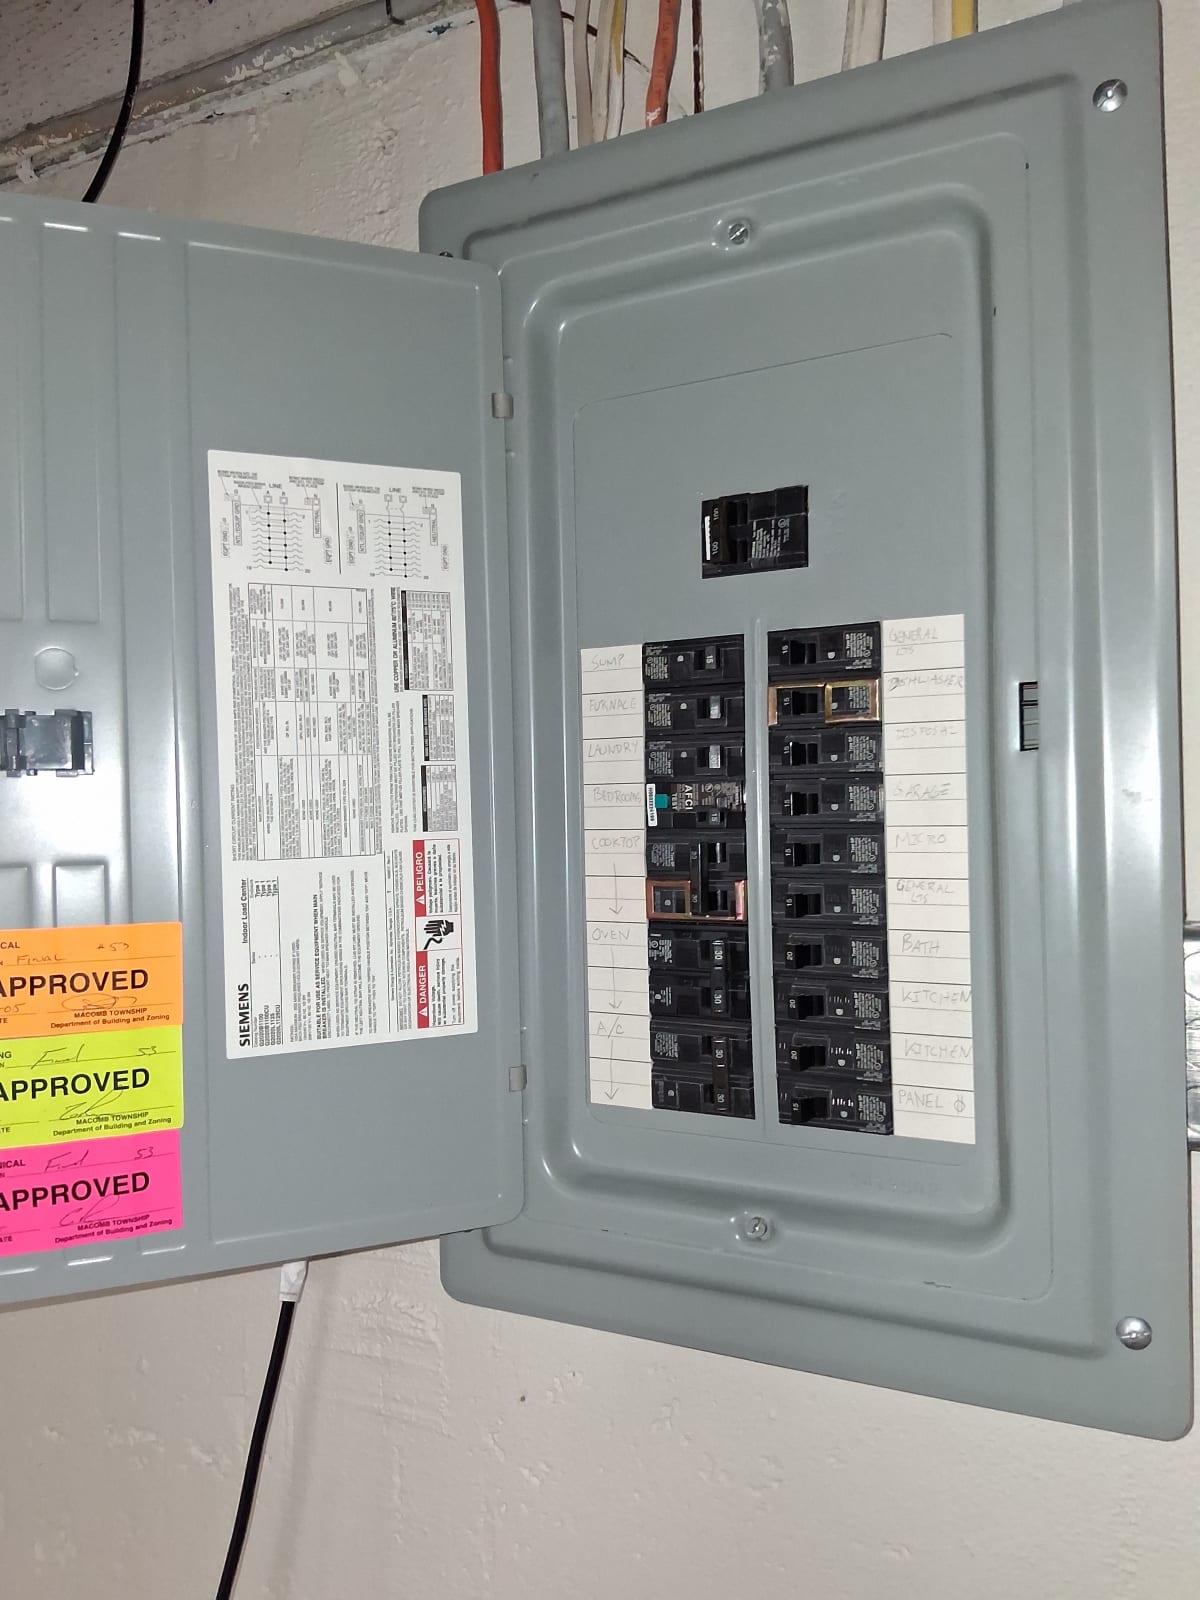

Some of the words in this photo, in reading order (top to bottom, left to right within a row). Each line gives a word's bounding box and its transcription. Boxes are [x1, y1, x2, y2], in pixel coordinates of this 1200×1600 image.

[592, 654, 624, 670] SUMP
[589, 698, 637, 712] FURNACE
[588, 740, 638, 758] LAUNDRY
[684, 784, 694, 810] AFCI
[592, 836, 640, 850] COOKTOP
[896, 832, 947, 848] MICRO
[416, 852, 424, 892] PELIGRO
[896, 879, 954, 894] GENERAL
[592, 928, 630, 940] OVEN
[902, 933, 940, 954] BATH
[714, 950, 723, 960] 30
[786, 952, 793, 960] 20
[418, 964, 427, 1004] DANGER
[714, 994, 722, 1005] 30
[902, 986, 972, 1004] KITCHEN
[789, 1000, 796, 1008] 20
[74, 1010, 107, 1018] MACOMB
[110, 1007, 148, 1016] TOWNSHIP
[237, 983, 250, 1047] SIEMENS
[50, 1020, 92, 1029] Department
[102, 1016, 130, 1026] Building
[147, 1014, 170, 1022] Zoning
[596, 1016, 624, 1038] A/C
[136, 1046, 157, 1057] 53
[716, 1048, 724, 1058] 30
[791, 1050, 798, 1060] 20
[904, 1038, 972, 1058] KITCHEN
[716, 1094, 724, 1104] 30
[898, 1090, 944, 1109] PANEL
[53, 1126, 94, 1137] Department
[104, 1122, 132, 1131] Building
[148, 1116, 172, 1126] Zoning
[76, 1117, 110, 1126] MACOMB
[112, 1112, 149, 1122] TOWNSHIP
[134, 1146, 154, 1160] 53
[0, 1172, 150, 1212] APPROVED
[78, 1221, 111, 1231] MACOMB
[112, 1214, 150, 1226] TOWNSHIP
[55, 1233, 96, 1244] Department
[105, 1226, 134, 1236] Building
[135, 1223, 148, 1231] and
[149, 1218, 173, 1229] Zoning
